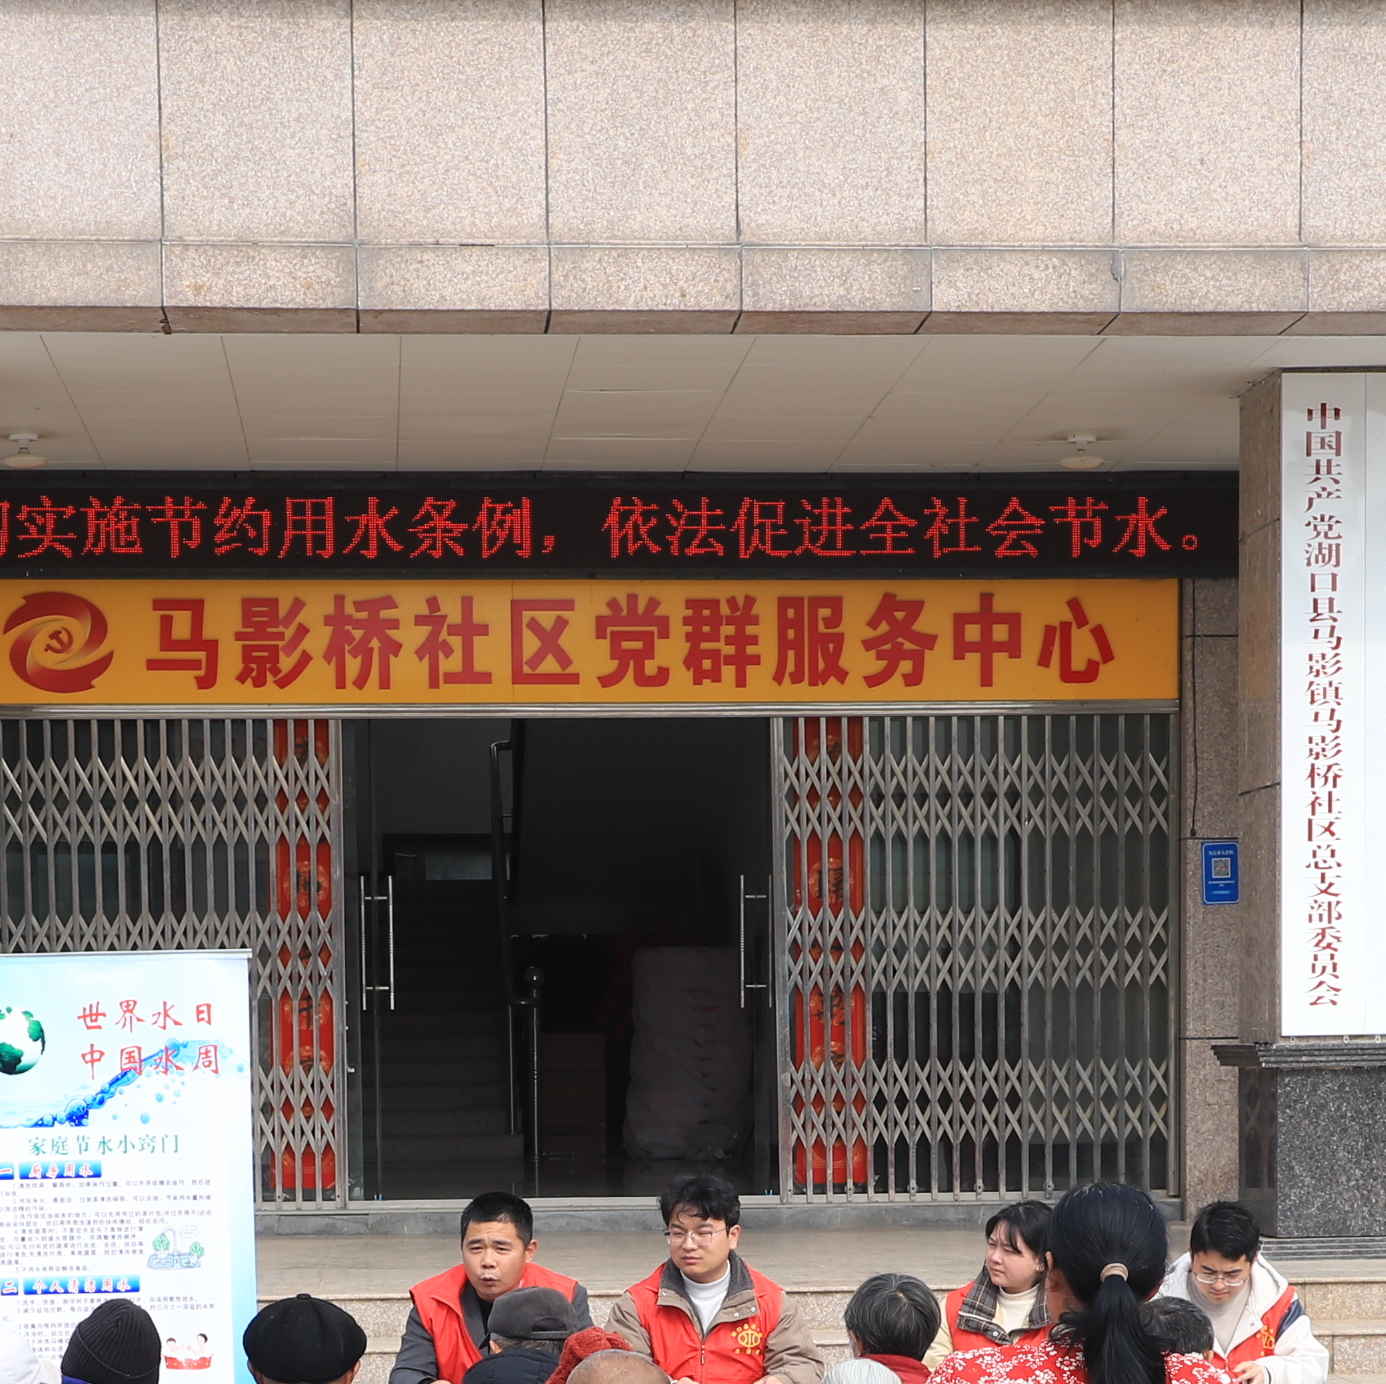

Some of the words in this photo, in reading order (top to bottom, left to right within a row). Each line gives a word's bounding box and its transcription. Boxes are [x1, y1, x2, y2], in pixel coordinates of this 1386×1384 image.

[146, 593, 1115, 690] 马影桥社区党群服务中心
[1303, 402, 1345, 1008] 中国共产党湖口县马影镇马影桥社区总支部委员会
[77, 999, 213, 1034] 世界水日
[81, 1043, 220, 1080] 中国水周
[27, 1133, 180, 1157] 家庭节水小窍门
[28, 1162, 94, 1179] 厨房用水
[32, 1277, 132, 1295] 个人清洁用水
